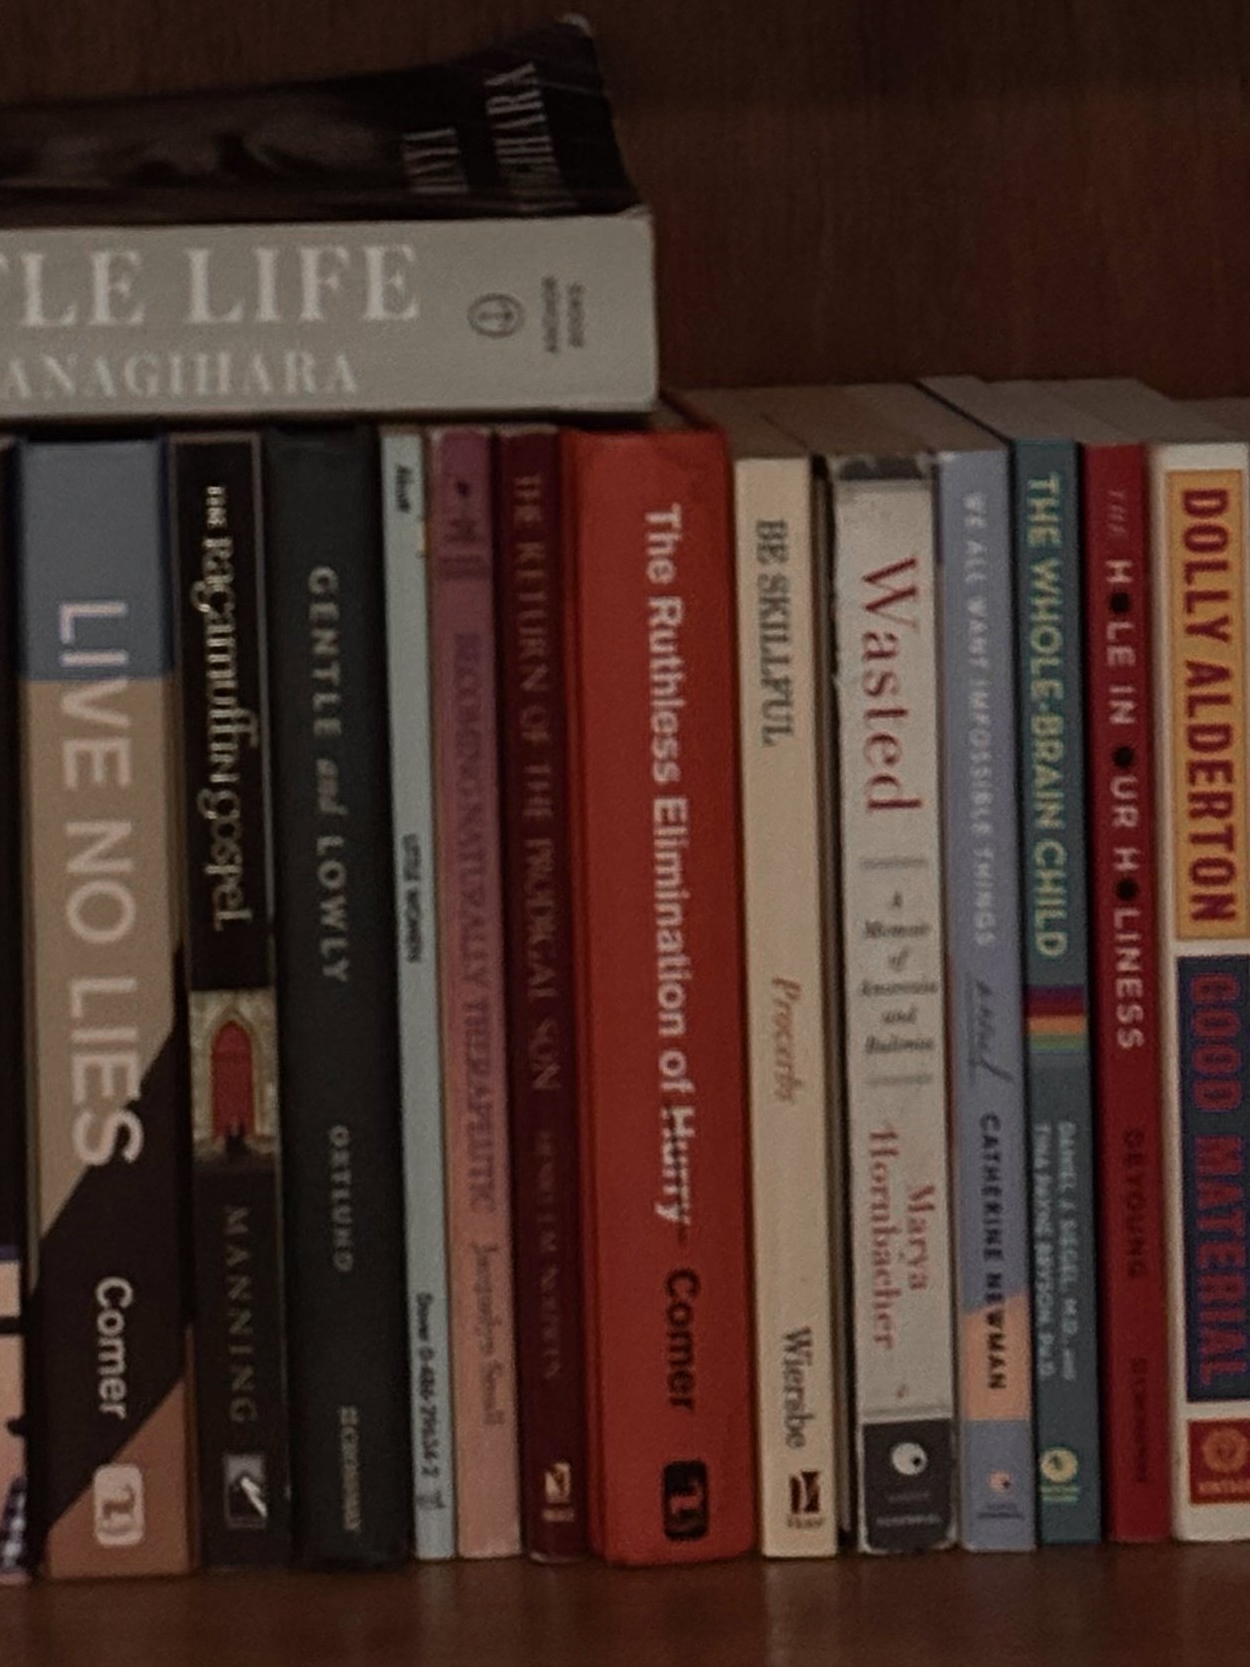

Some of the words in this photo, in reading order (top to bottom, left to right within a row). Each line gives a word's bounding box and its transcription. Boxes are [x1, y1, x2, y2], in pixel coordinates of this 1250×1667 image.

[182, 241, 423, 325] LIFE
[643, 501, 686, 586] The
[753, 517, 791, 566] BE
[961, 489, 991, 531] WE
[963, 538, 993, 585] ALL
[1025, 470, 1064, 548] THE
[1179, 486, 1234, 647] DOLLY
[57, 596, 135, 793] LIVE
[307, 563, 344, 738] GENTLE
[647, 593, 689, 786] Ruthless
[757, 571, 797, 750] SKILLFUL
[859, 555, 927, 817] Wasted
[964, 591, 994, 668] WANT
[1029, 555, 1067, 830] WHOLE-BRAIN
[967, 678, 997, 835] IMPOSSIBLE
[1107, 684, 1139, 727] IN
[313, 754, 350, 819] and
[1185, 656, 1240, 927] ALDERTON
[62, 816, 139, 947] NO
[315, 833, 352, 987] LOWLY
[650, 793, 694, 1037] Elimination
[971, 842, 1000, 948] THINGS
[1032, 836, 1070, 958] CHILD
[65, 974, 147, 1168] LIES
[657, 1046, 697, 1094] of
[1191, 972, 1244, 1115] GOOD
[652, 1103, 701, 1232] Hurry
[867, 1127, 904, 1352] Hornbacher
[902, 1183, 937, 1291] Marya
[980, 1111, 1008, 1262] CATHERINE
[221, 1204, 260, 1428] MANNING
[984, 1270, 1011, 1392] NEWMAN
[1194, 1133, 1250, 1386] MATERIAL
[93, 1274, 136, 1423] Comer
[664, 1265, 704, 1416] Comer
[781, 1326, 818, 1453] Wiersbe
